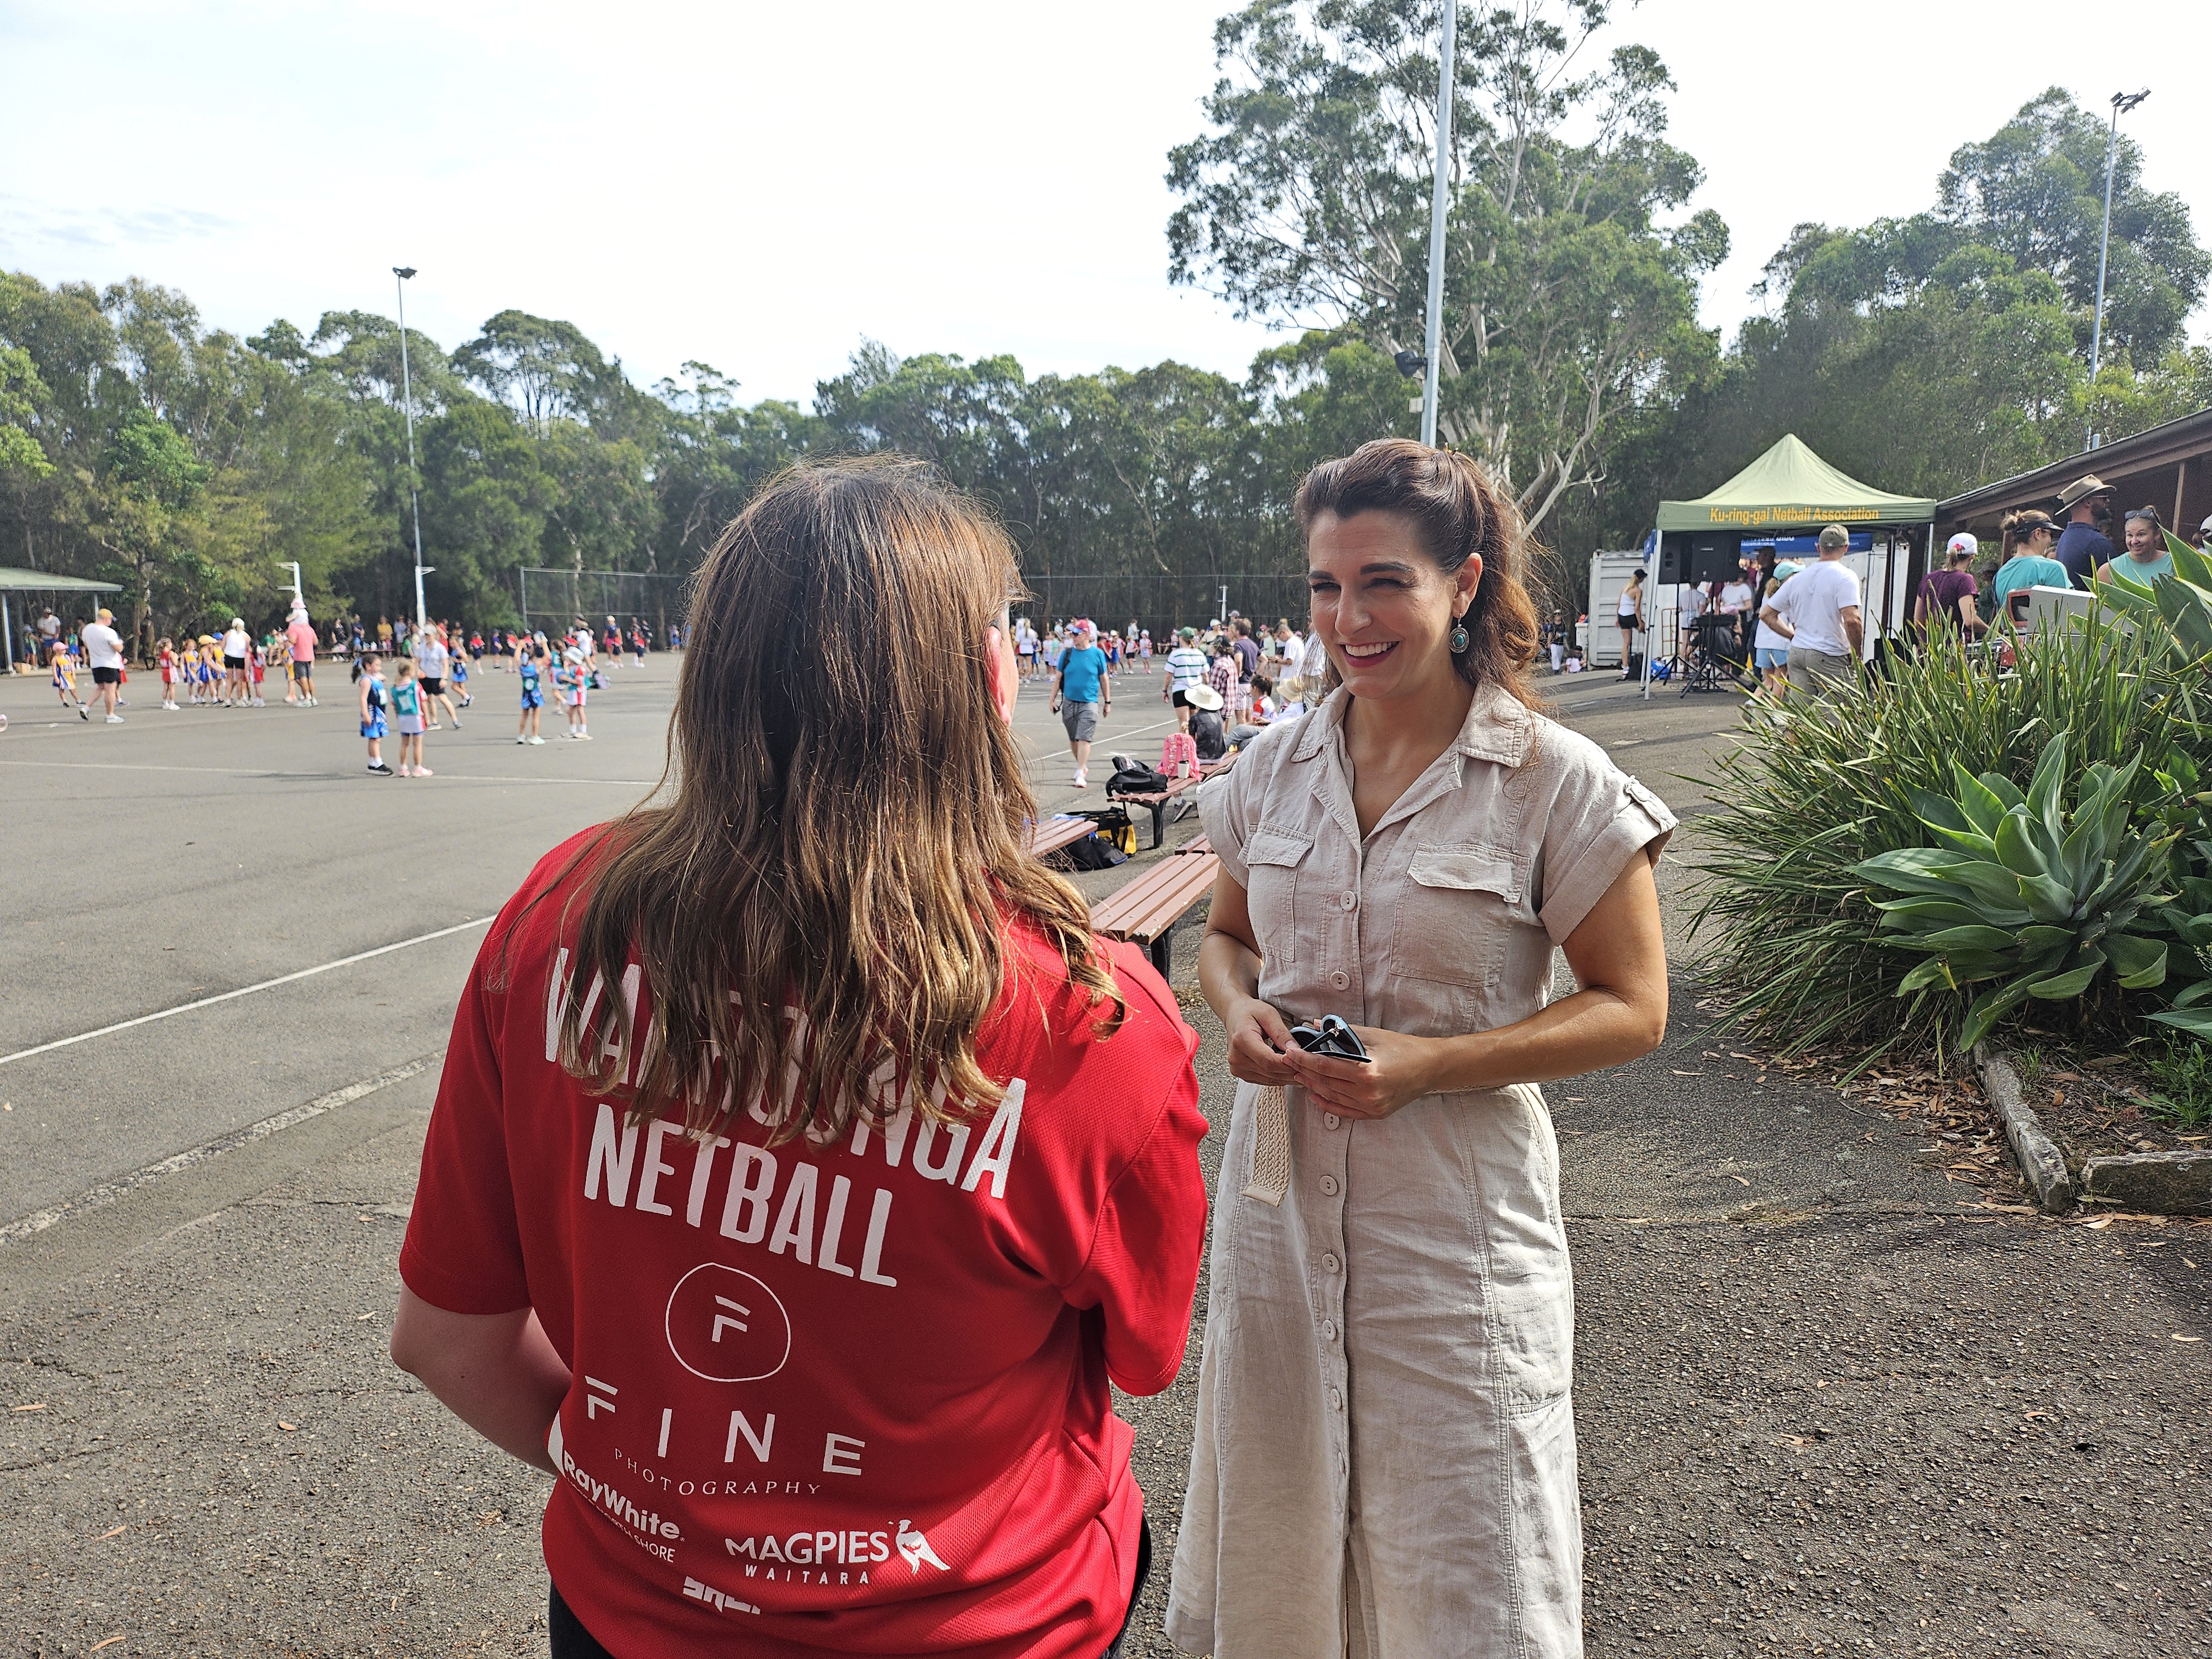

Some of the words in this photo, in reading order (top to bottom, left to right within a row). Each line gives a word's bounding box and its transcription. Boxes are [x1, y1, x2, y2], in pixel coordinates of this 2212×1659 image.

[1709, 507, 1770, 525] Ku-ring-gai
[1772, 507, 1812, 521] Netball
[1812, 507, 1880, 521] Association
[584, 1103, 897, 1287] NETBALL
[585, 1375, 865, 1475] FINE
[615, 1448, 820, 1495] PHOTOGRAPHY
[634, 1535, 675, 1563] SHORE
[725, 1530, 890, 1564] MAGPIES
[745, 1564, 869, 1585] WAITARA
